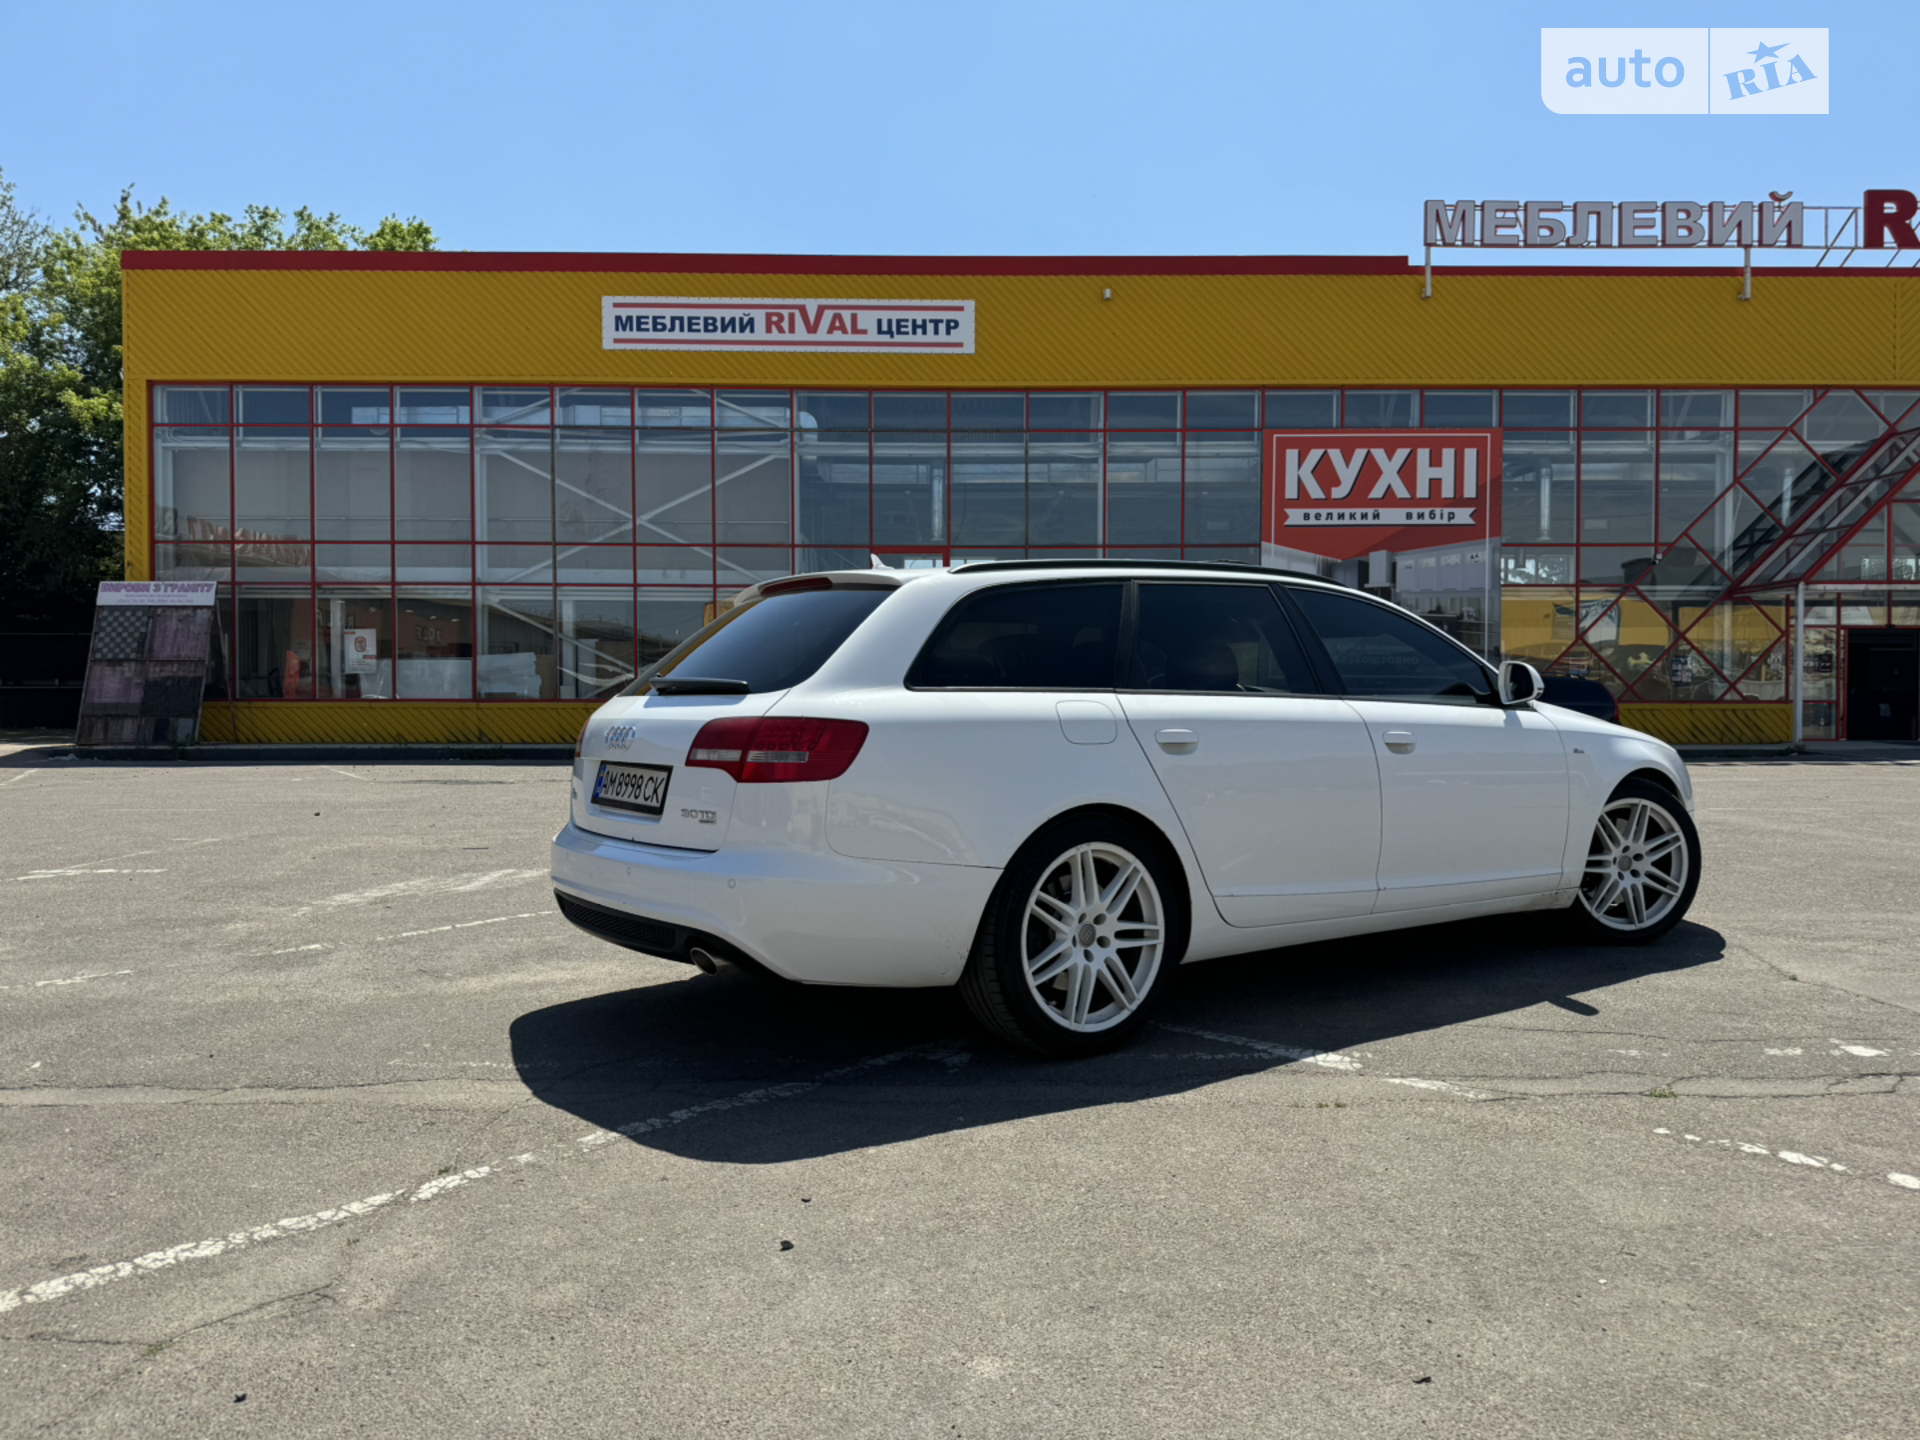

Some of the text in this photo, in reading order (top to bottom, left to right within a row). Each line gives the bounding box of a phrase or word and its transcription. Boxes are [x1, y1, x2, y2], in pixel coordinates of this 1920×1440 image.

[1424, 189, 1920, 249] МЕБЛЕВИЙ R
[613, 304, 960, 339] МЕБЛЕВИЙ RIVAL ЦЕНТР
[1284, 447, 1479, 500] КУХНІ
[1303, 508, 1456, 523] великий вибір
[615, 772, 644, 800] 8998
[643, 775, 665, 804] CK
